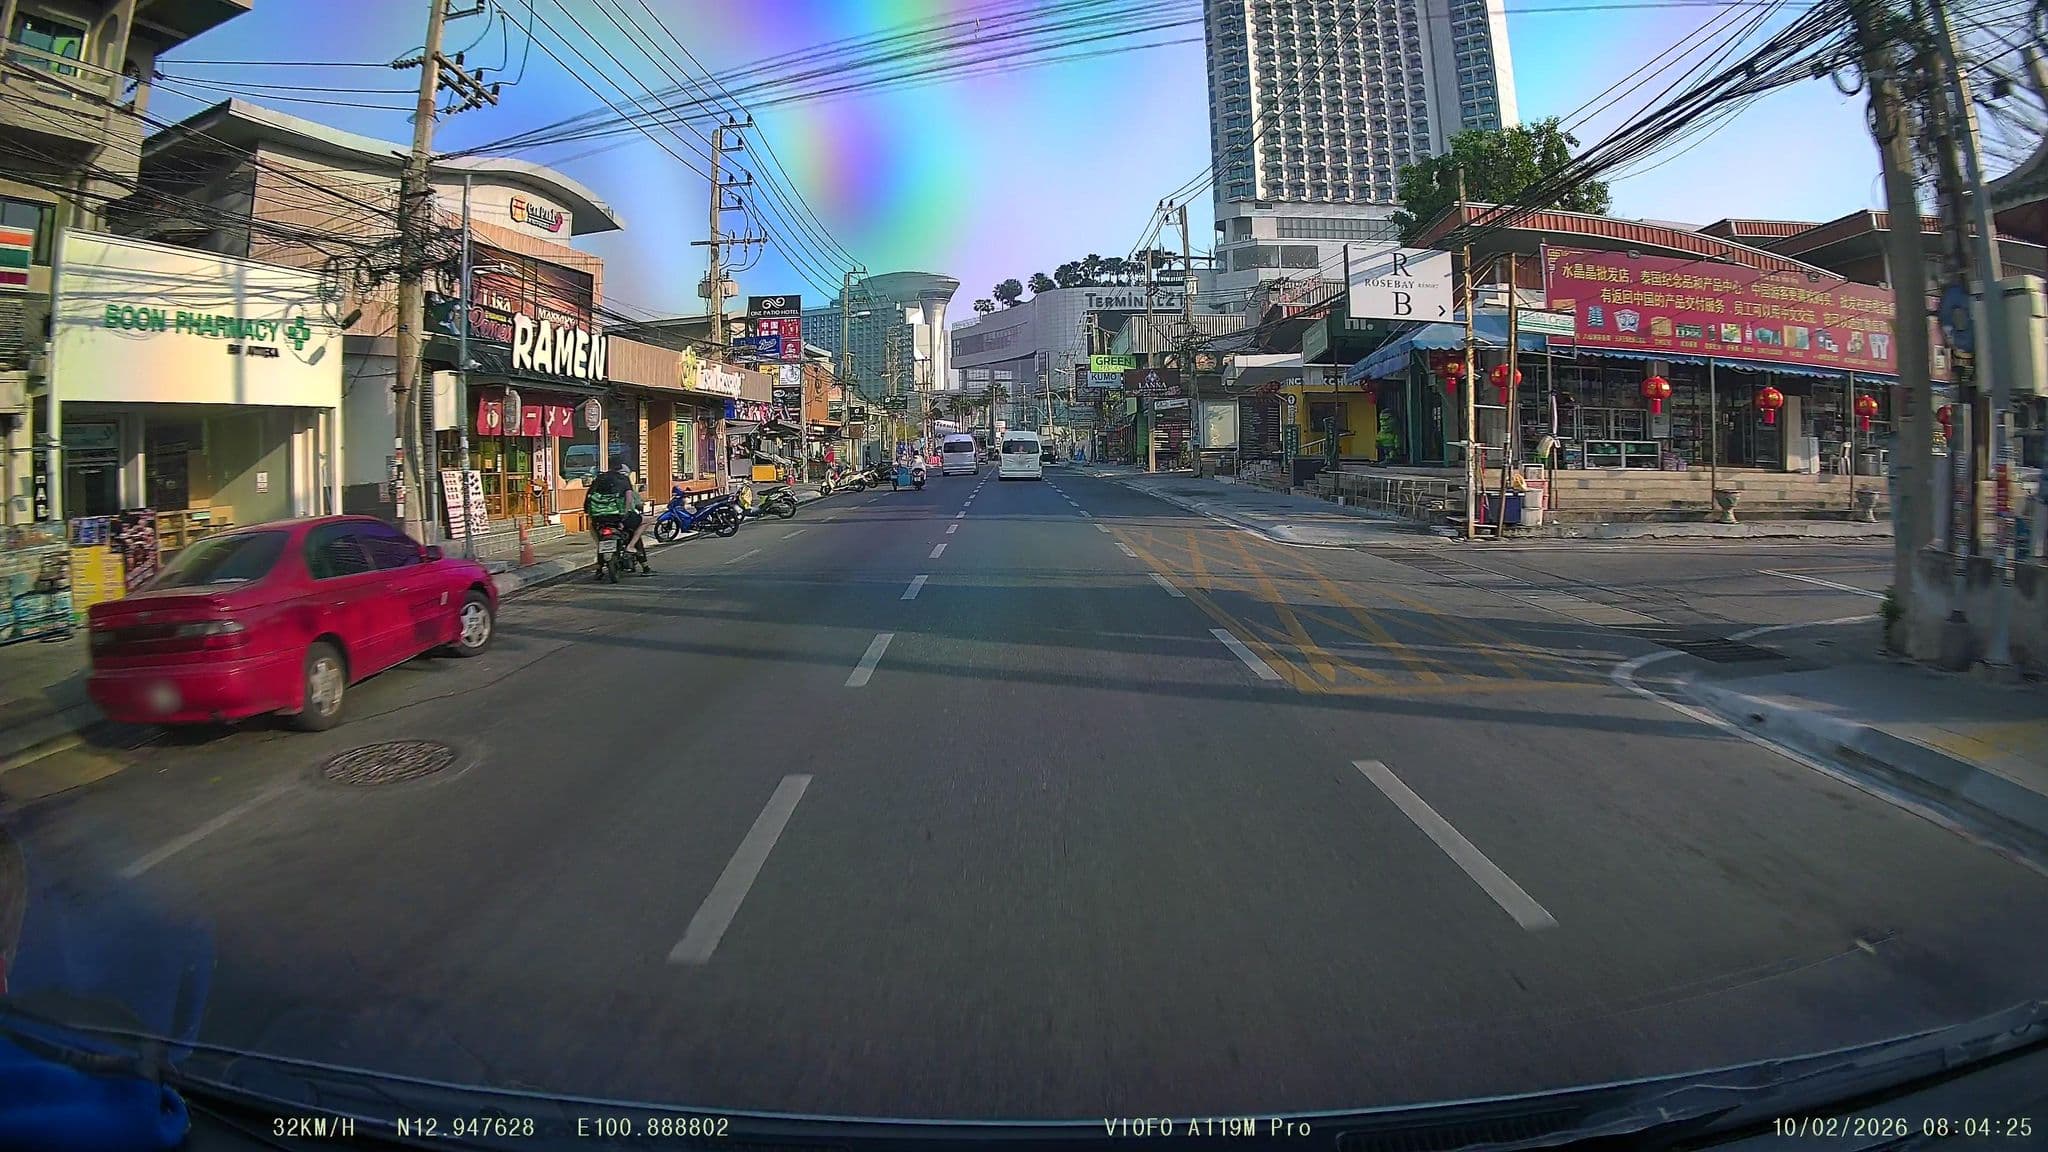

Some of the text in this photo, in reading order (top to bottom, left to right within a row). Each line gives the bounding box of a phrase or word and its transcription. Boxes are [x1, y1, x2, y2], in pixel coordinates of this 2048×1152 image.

[1393, 252, 1412, 277] R
[1364, 278, 1415, 289] ROSEBAY
[1393, 291, 1413, 316] B
[104, 304, 280, 342] BOON PHARMACY
[512, 312, 606, 381] RAMEN
[1095, 356, 1133, 367] GREEN
[1091, 373, 1117, 381] KUMO
